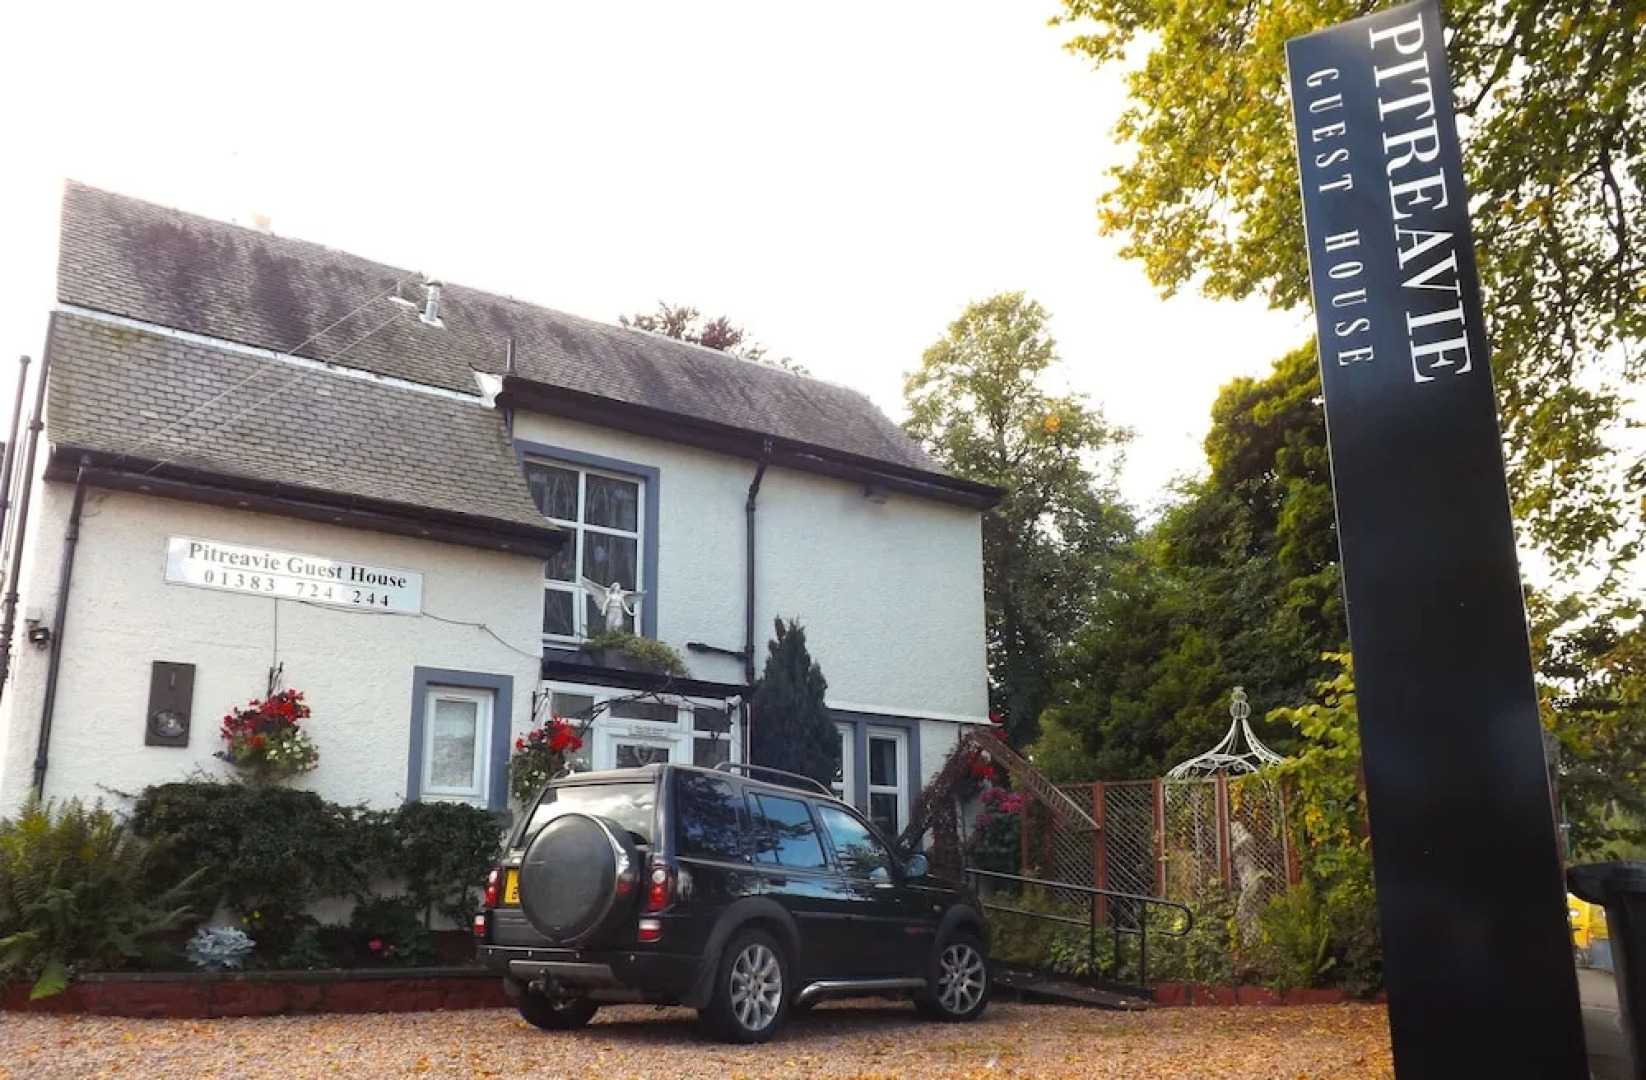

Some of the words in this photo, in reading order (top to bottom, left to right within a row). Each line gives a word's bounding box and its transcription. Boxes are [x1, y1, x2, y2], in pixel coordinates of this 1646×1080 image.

[1306, 68, 1354, 192] GUEST
[1369, 13, 1473, 383] PITREAVIE
[1324, 229, 1374, 367] HOUSE
[189, 542, 280, 571] Pitreavie
[288, 557, 343, 579] Guest
[350, 566, 407, 588] House
[204, 570, 276, 592] 01383
[296, 583, 334, 599] 724
[352, 590, 389, 607] 244
